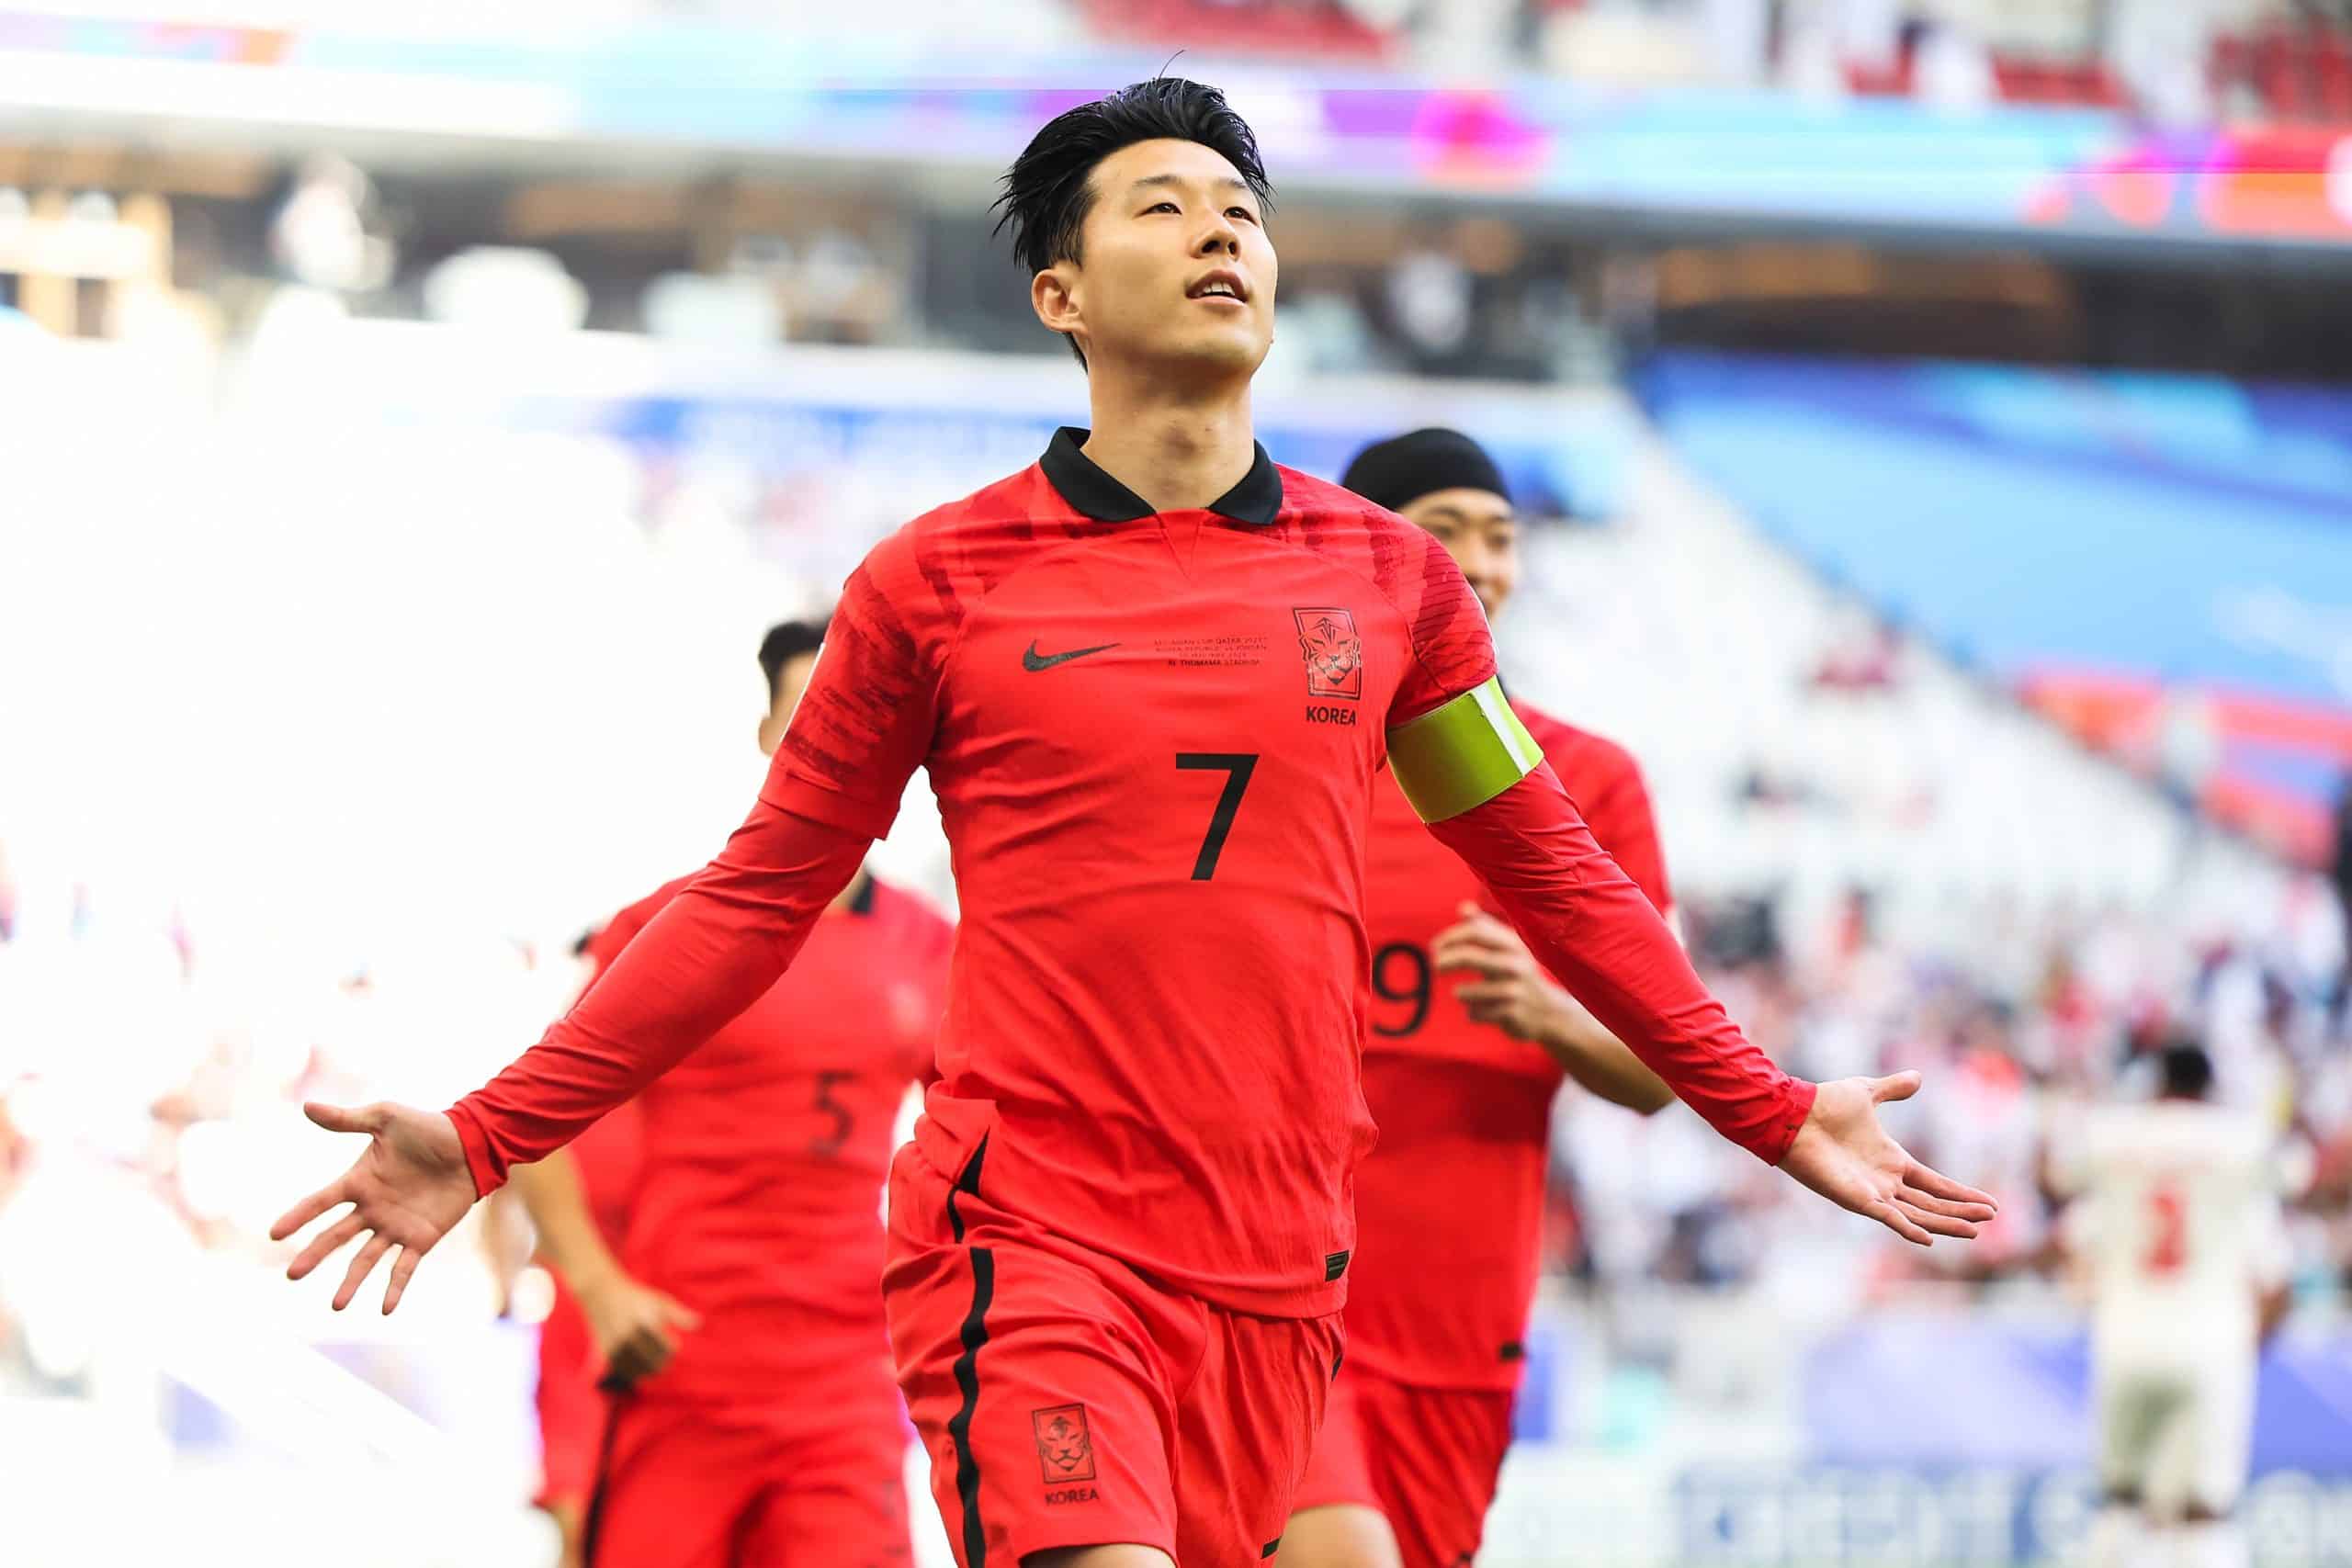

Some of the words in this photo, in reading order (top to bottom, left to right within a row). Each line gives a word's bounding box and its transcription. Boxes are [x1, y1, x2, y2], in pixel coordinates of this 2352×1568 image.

[1306, 705, 1357, 726] KOREA
[1175, 751, 1260, 881] 7
[1373, 940, 1430, 1039] 9
[809, 1068, 860, 1157] 5
[1045, 1488, 1100, 1506] KOREA
